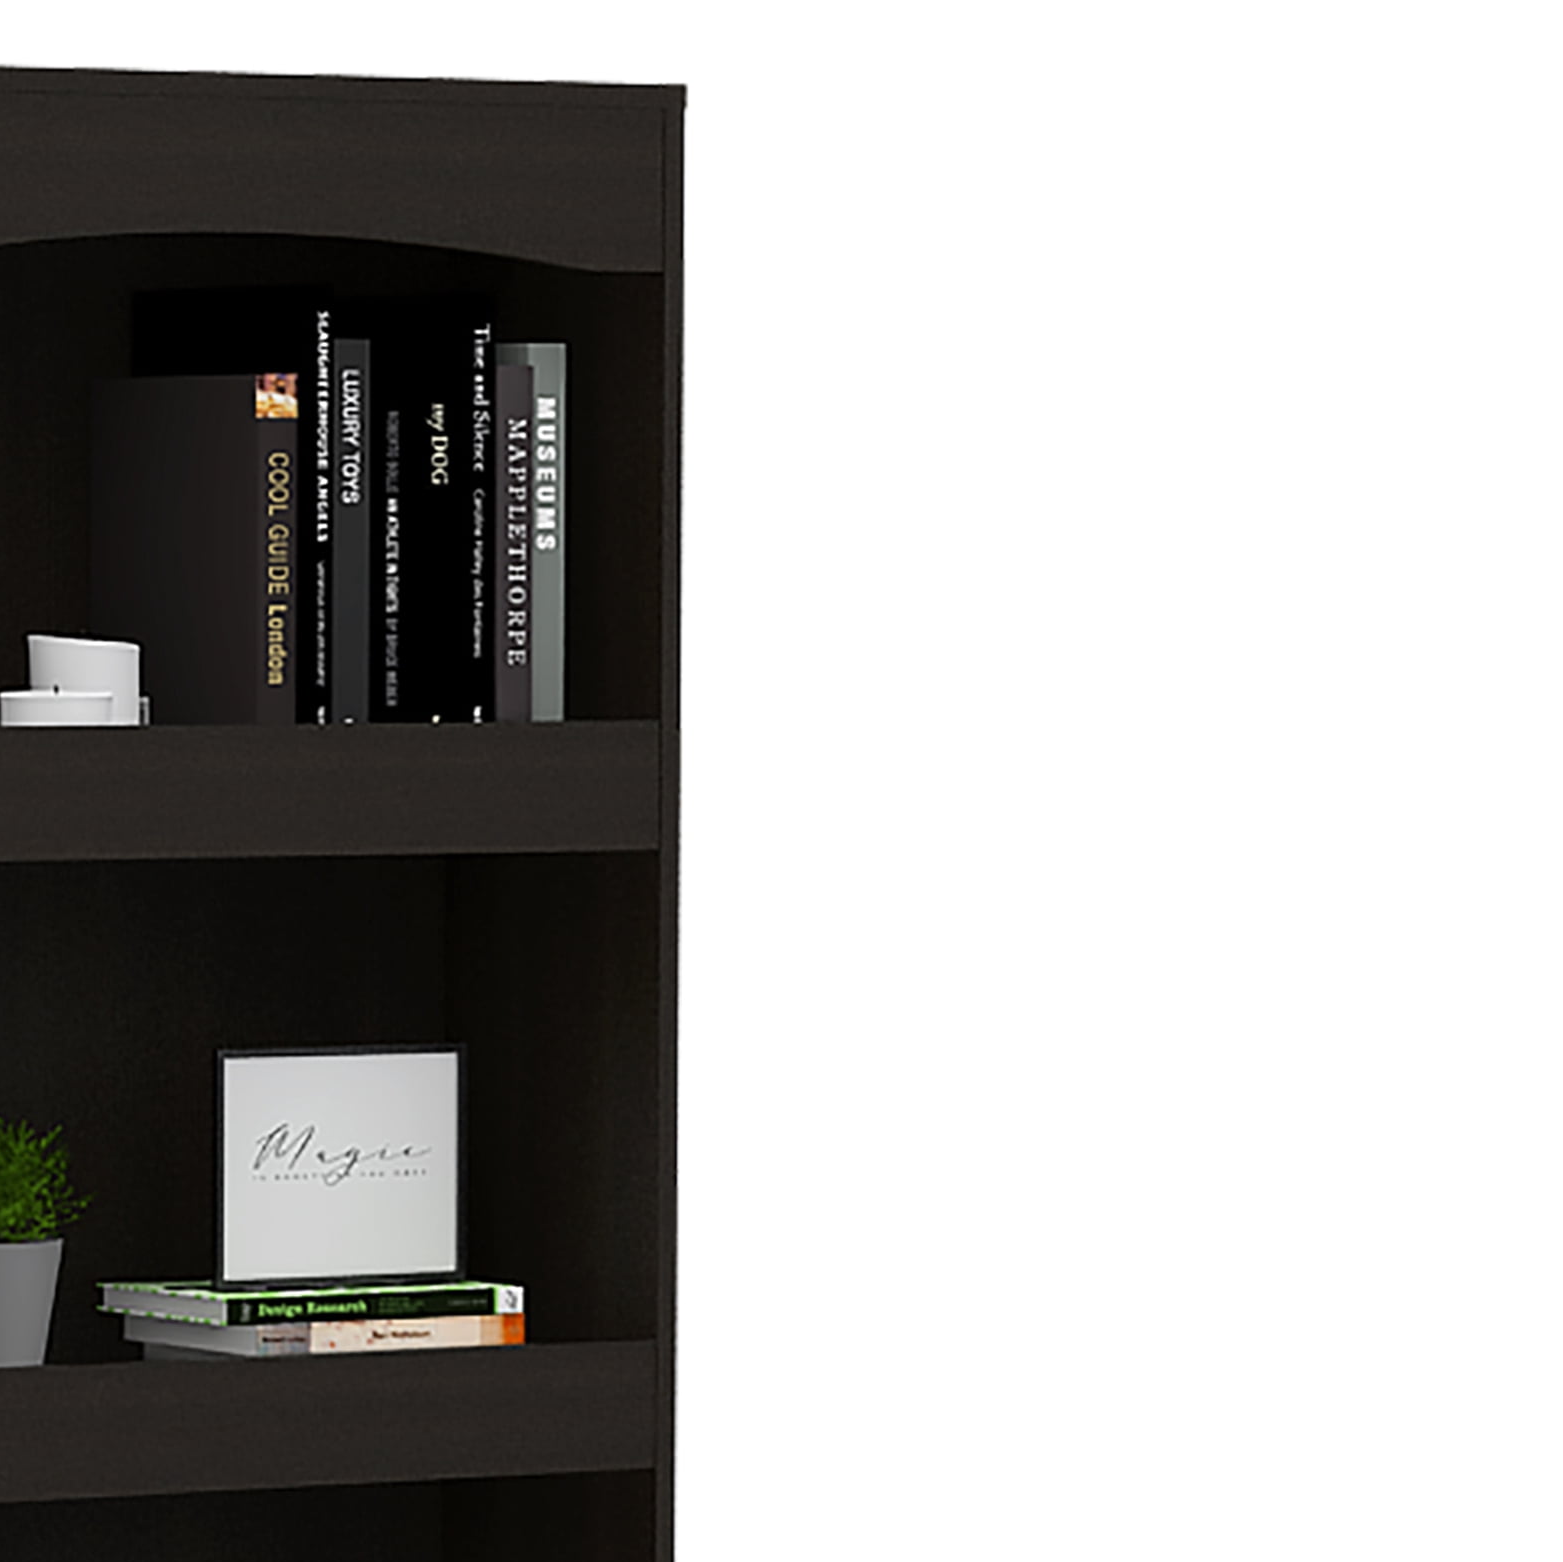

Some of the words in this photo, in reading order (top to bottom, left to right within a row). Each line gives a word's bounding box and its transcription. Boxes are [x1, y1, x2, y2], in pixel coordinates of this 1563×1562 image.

[473, 323, 491, 369] Time
[316, 311, 330, 469] SLAUGHTERHOUSE
[342, 369, 361, 447] LUXURY
[426, 403, 445, 432] my
[473, 374, 490, 406] and
[430, 435, 449, 485] DOG
[473, 410, 491, 472] Silence
[535, 397, 557, 550] MUSEUMS
[268, 452, 290, 517] COOL
[316, 475, 329, 543] ANGELS
[341, 452, 361, 504] TOYS
[267, 524, 290, 595] GUIDE
[507, 418, 528, 666] MAPPLETHORPE
[267, 604, 288, 685] London
[252, 1122, 432, 1188] Magic
[257, 1302, 304, 1318] Design
